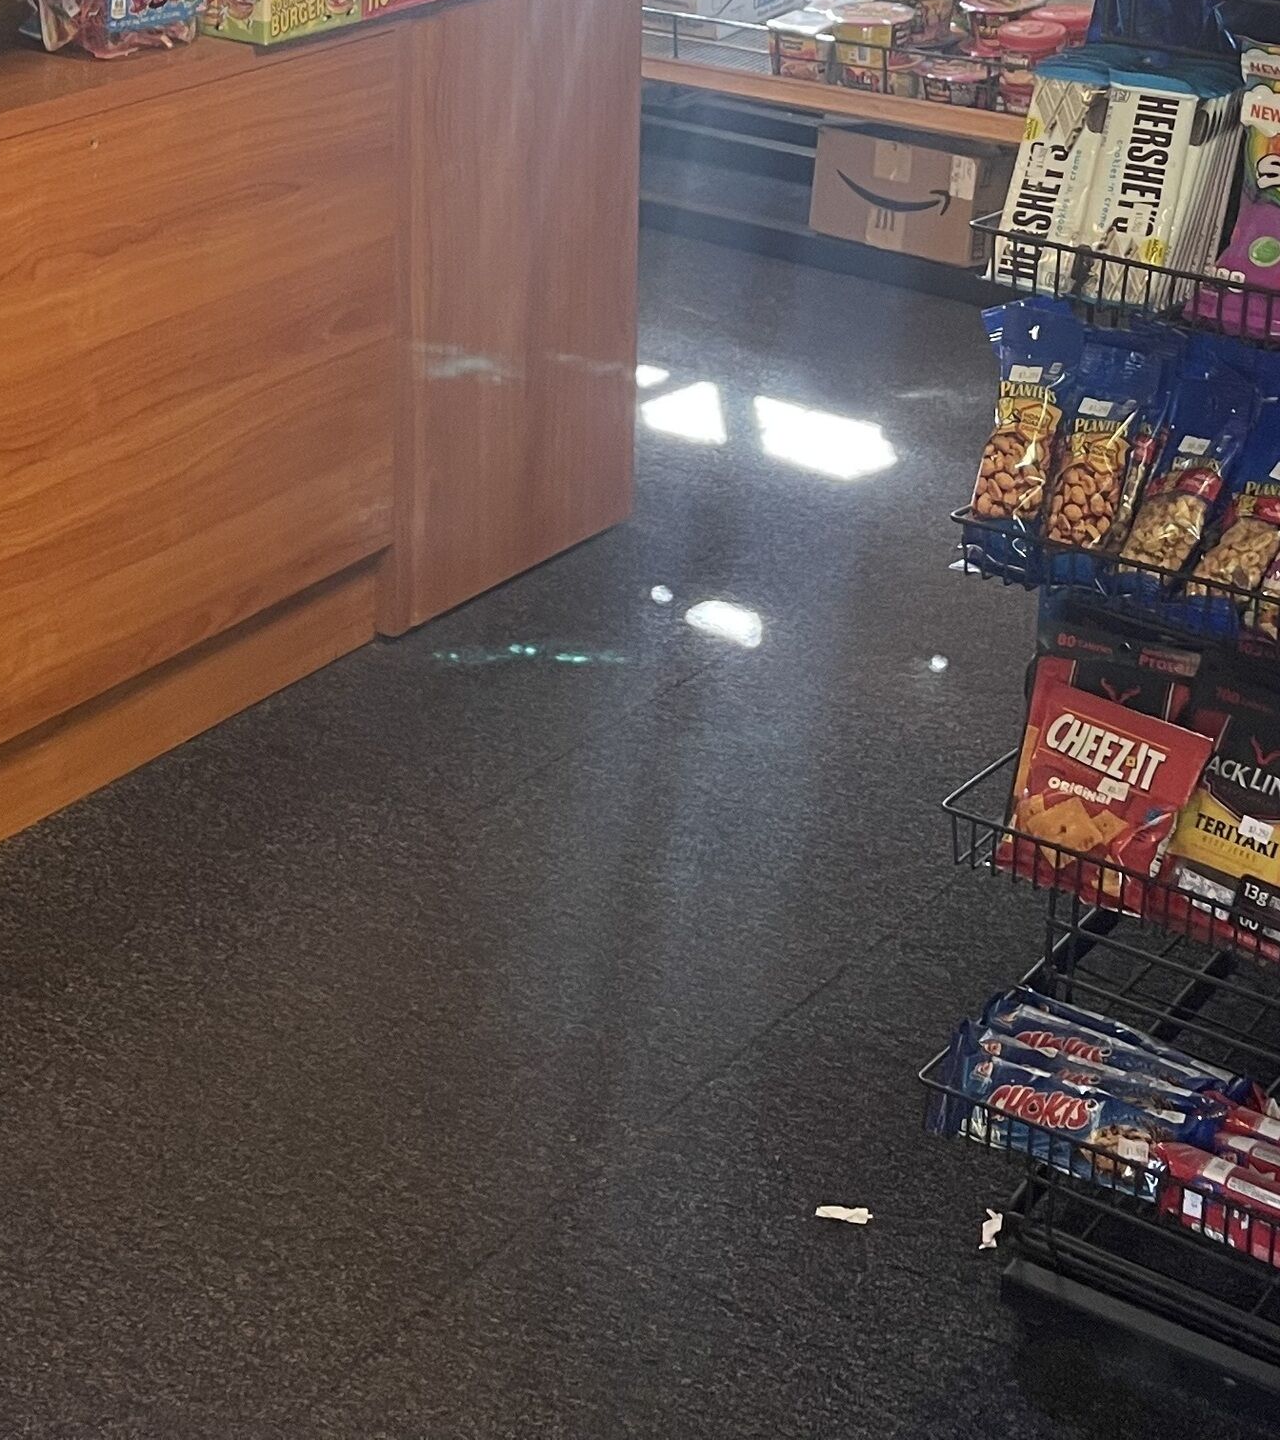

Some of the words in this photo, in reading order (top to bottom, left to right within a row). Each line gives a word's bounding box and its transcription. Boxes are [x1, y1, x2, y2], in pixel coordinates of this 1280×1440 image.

[1000, 379, 1057, 404] PLANTERS
[1074, 417, 1129, 436] PLANTERS
[1243, 881, 1270, 907] 13g
